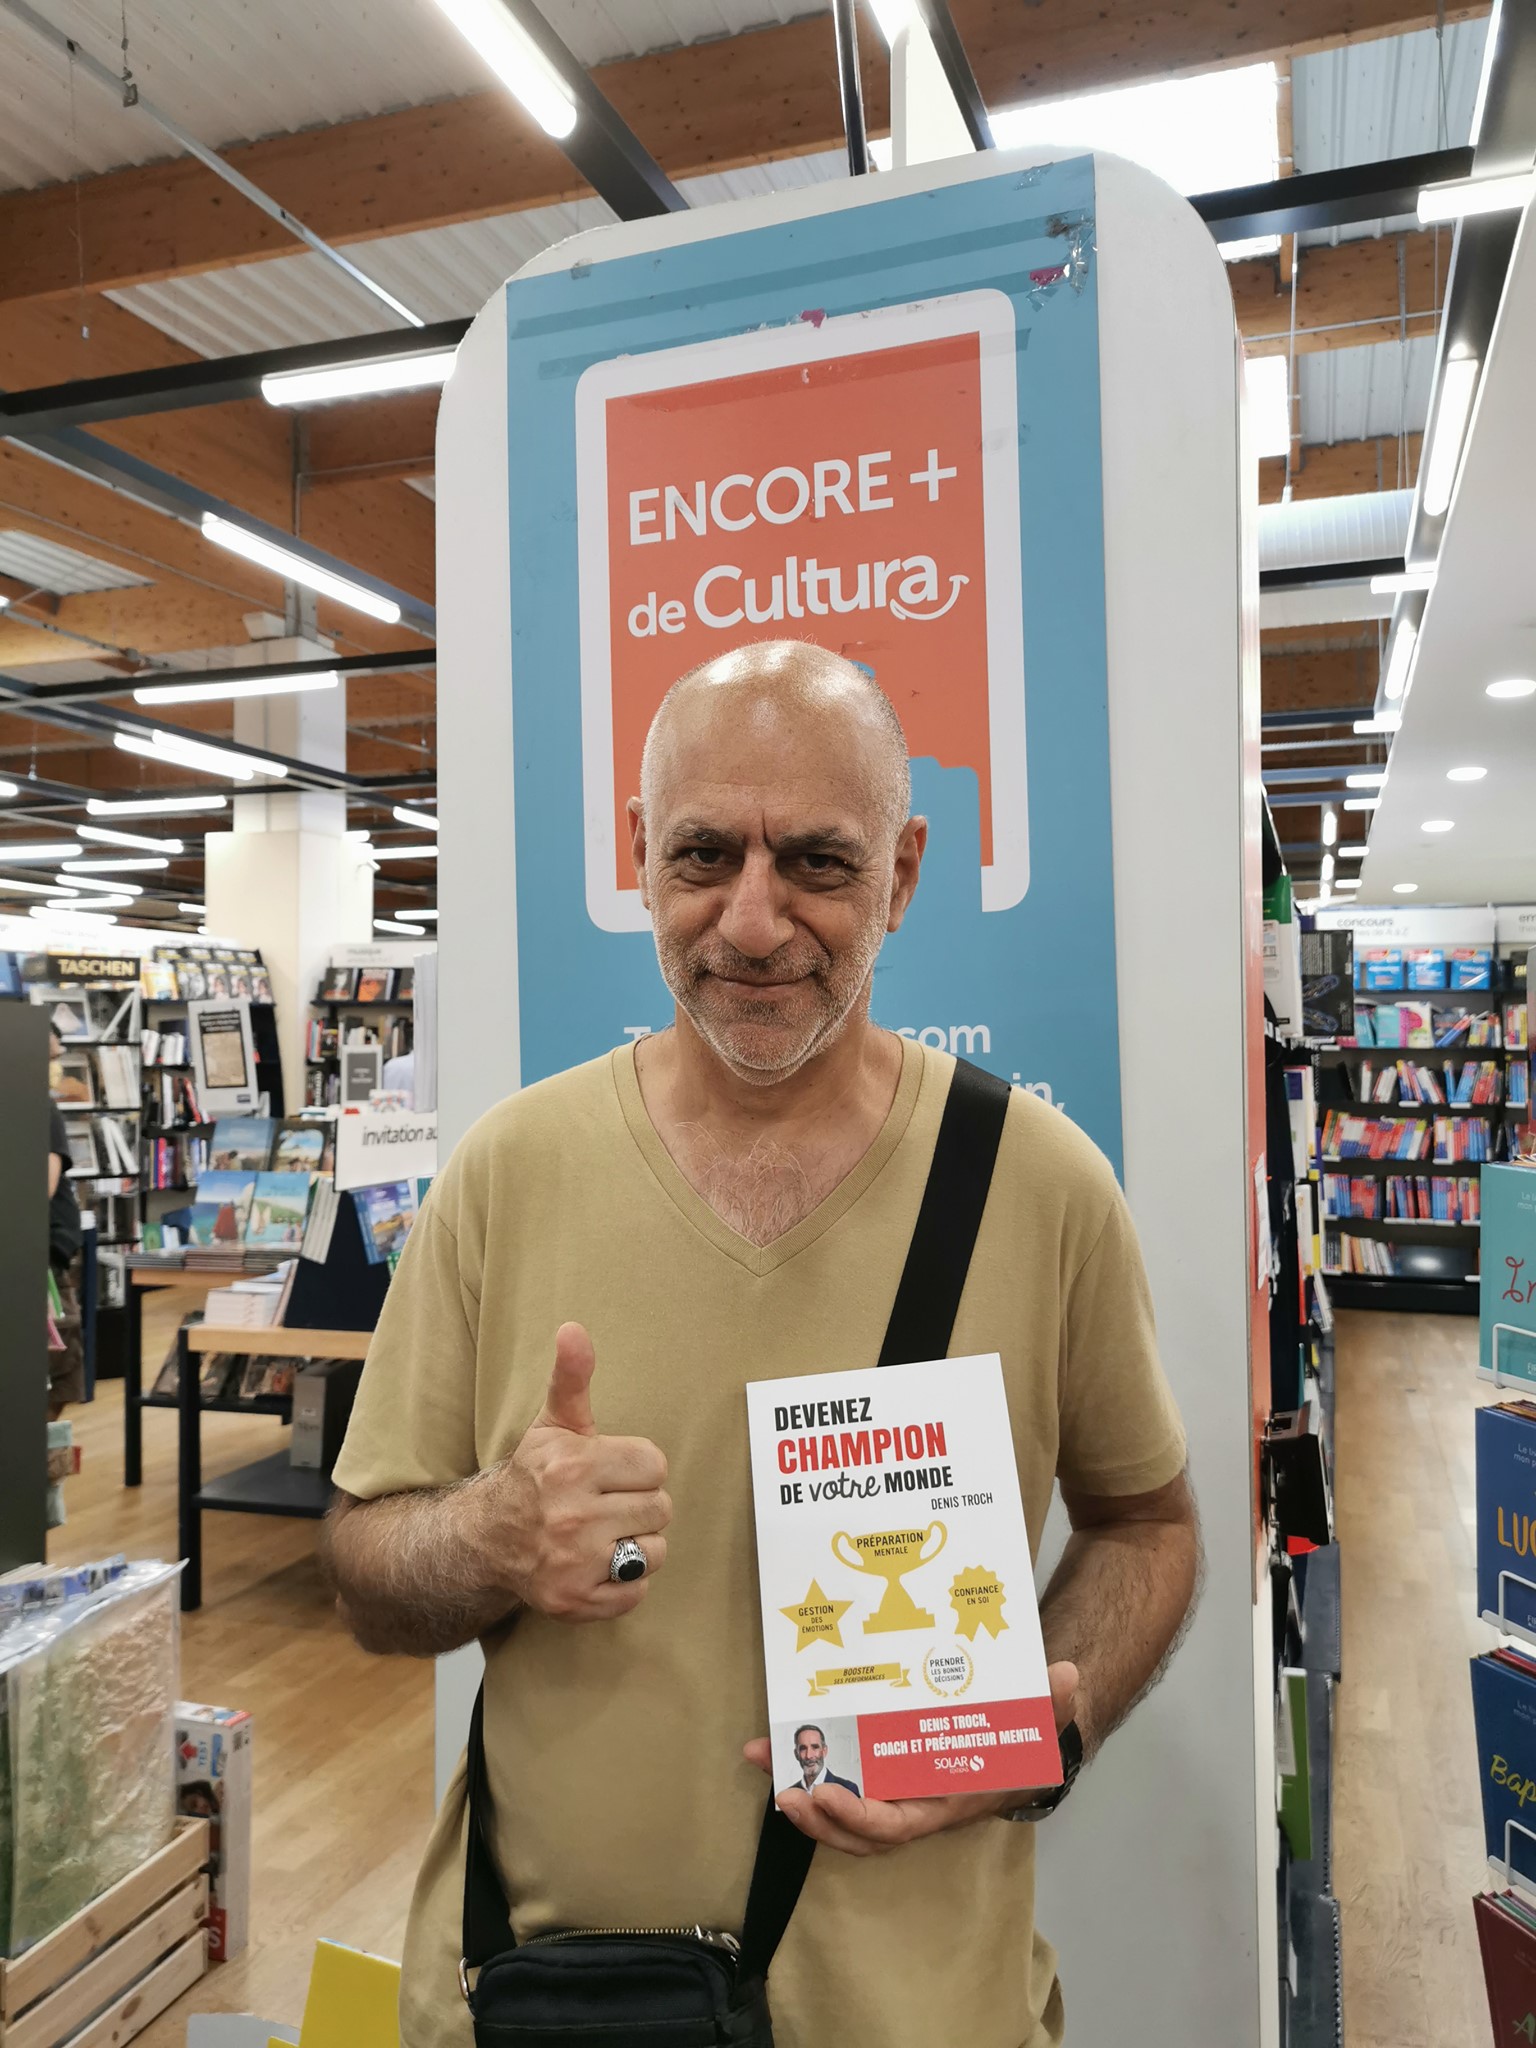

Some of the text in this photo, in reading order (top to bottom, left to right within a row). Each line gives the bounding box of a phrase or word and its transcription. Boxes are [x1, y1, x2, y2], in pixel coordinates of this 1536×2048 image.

[629, 450, 894, 546] ENCORE
[627, 554, 940, 638] de Cultura
[1336, 917, 1394, 928] concours
[57, 958, 136, 976] TASCHEN
[362, 1123, 424, 1146] invitation
[774, 1396, 873, 1432] DEVENEZ
[777, 1421, 948, 1475] CHAMPION
[780, 1465, 954, 1505] DE votre MONDE
[931, 1492, 994, 1510] DENIS TROCH
[856, 1531, 924, 1549] PRÉPARATION
[874, 1546, 909, 1557] MENTALE
[954, 1584, 1000, 1598] CONFIANCE
[966, 1596, 990, 1606] EN SOI
[798, 1604, 834, 1617] GESTION
[810, 1616, 823, 1624] DES
[801, 1623, 834, 1634] ÉMOTIONS
[929, 1656, 965, 1667] PRENDRE
[842, 1665, 875, 1677] BOOSTER
[930, 1665, 966, 1675] LES BONNES
[833, 1674, 886, 1685] SES PERFORMANCES
[934, 1673, 965, 1683] DÉCISIONS
[919, 1713, 991, 1733] DENIS TROCH,
[873, 1727, 1043, 1757] COACH ET PRÉPARATEUR MENTAL
[934, 1756, 969, 1770] SOLAR
